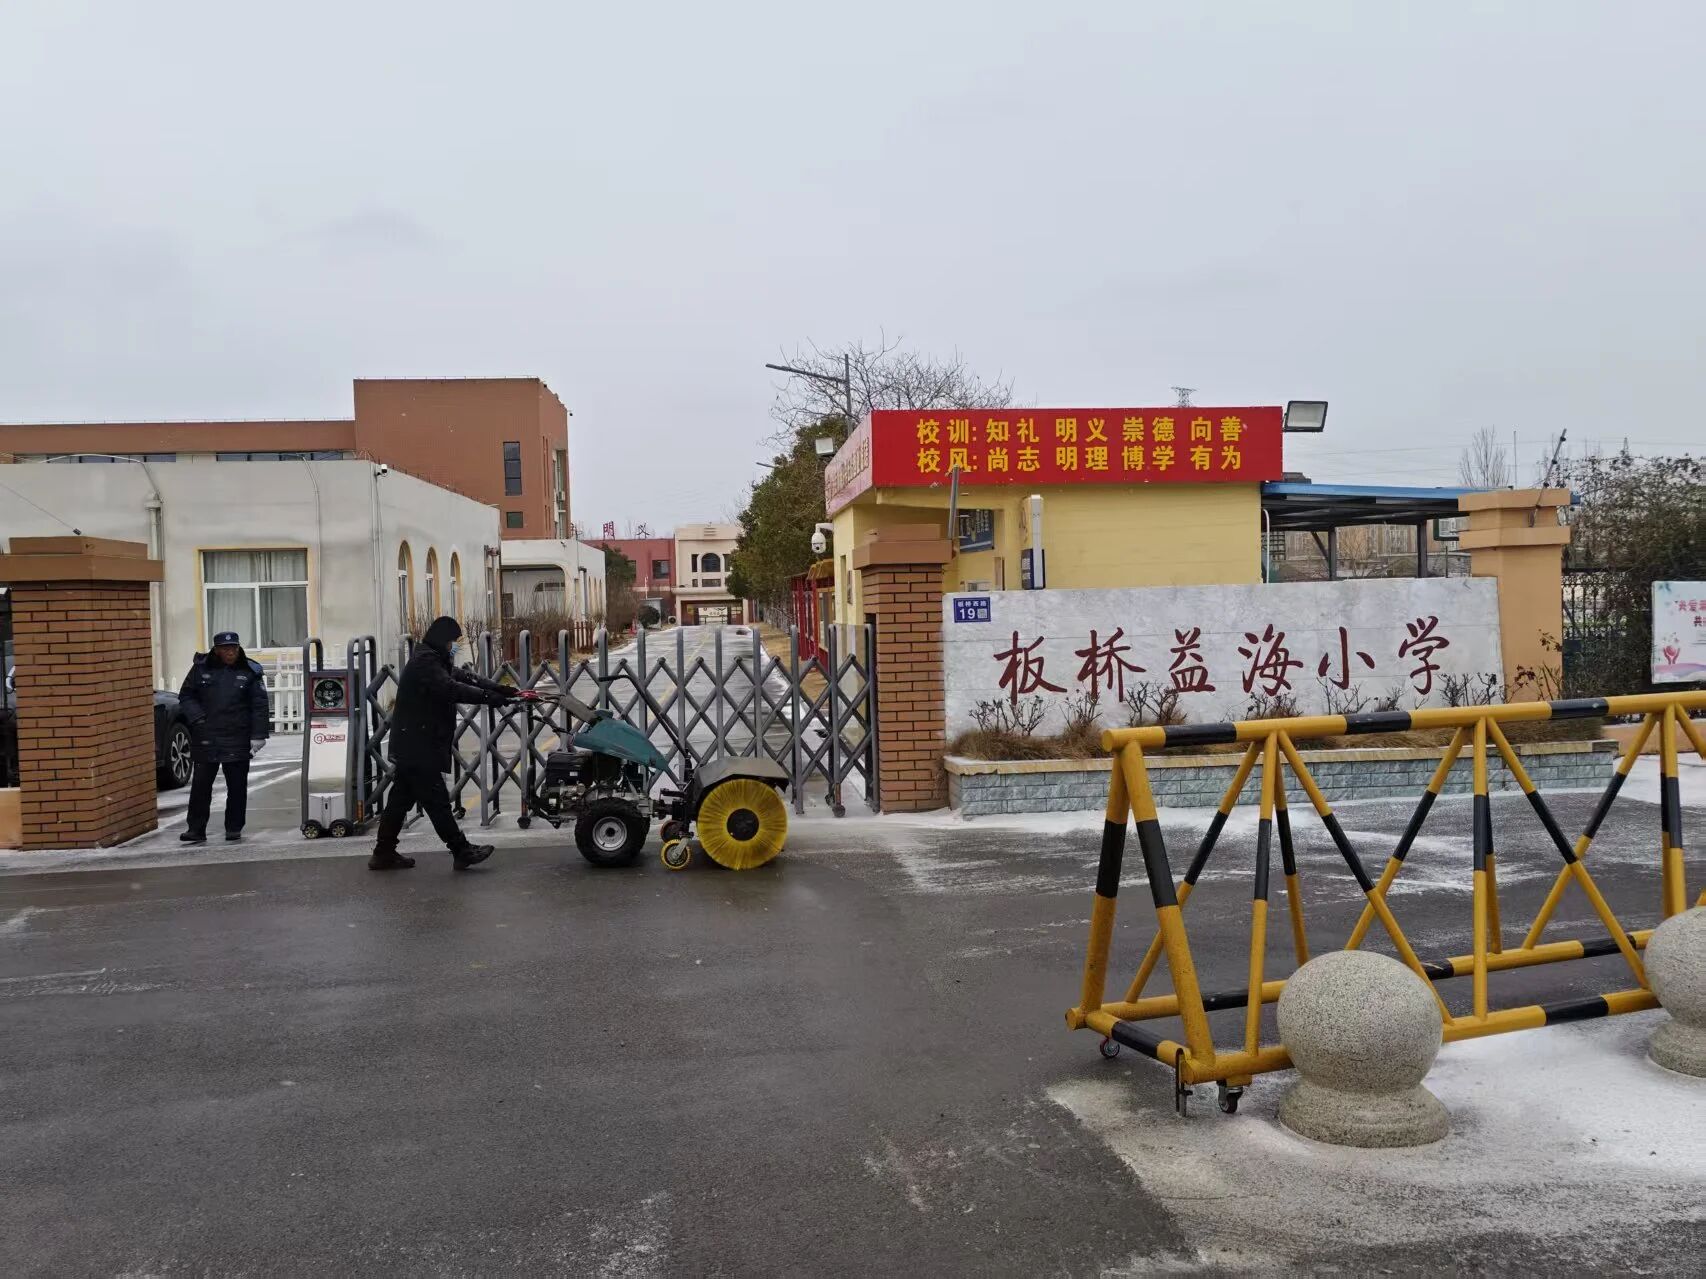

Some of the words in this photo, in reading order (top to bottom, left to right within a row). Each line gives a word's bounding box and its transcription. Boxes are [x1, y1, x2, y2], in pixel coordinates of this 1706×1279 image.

[1055, 418, 1108, 443] 明义
[1122, 416, 1175, 442] 崇德
[1190, 416, 1242, 442] 向善
[1055, 446, 1109, 471] 明理
[1121, 445, 1175, 471] 博学
[1189, 445, 1242, 471] 有为
[959, 607, 976, 620] 19
[994, 616, 1450, 704] 板桥益海小学
